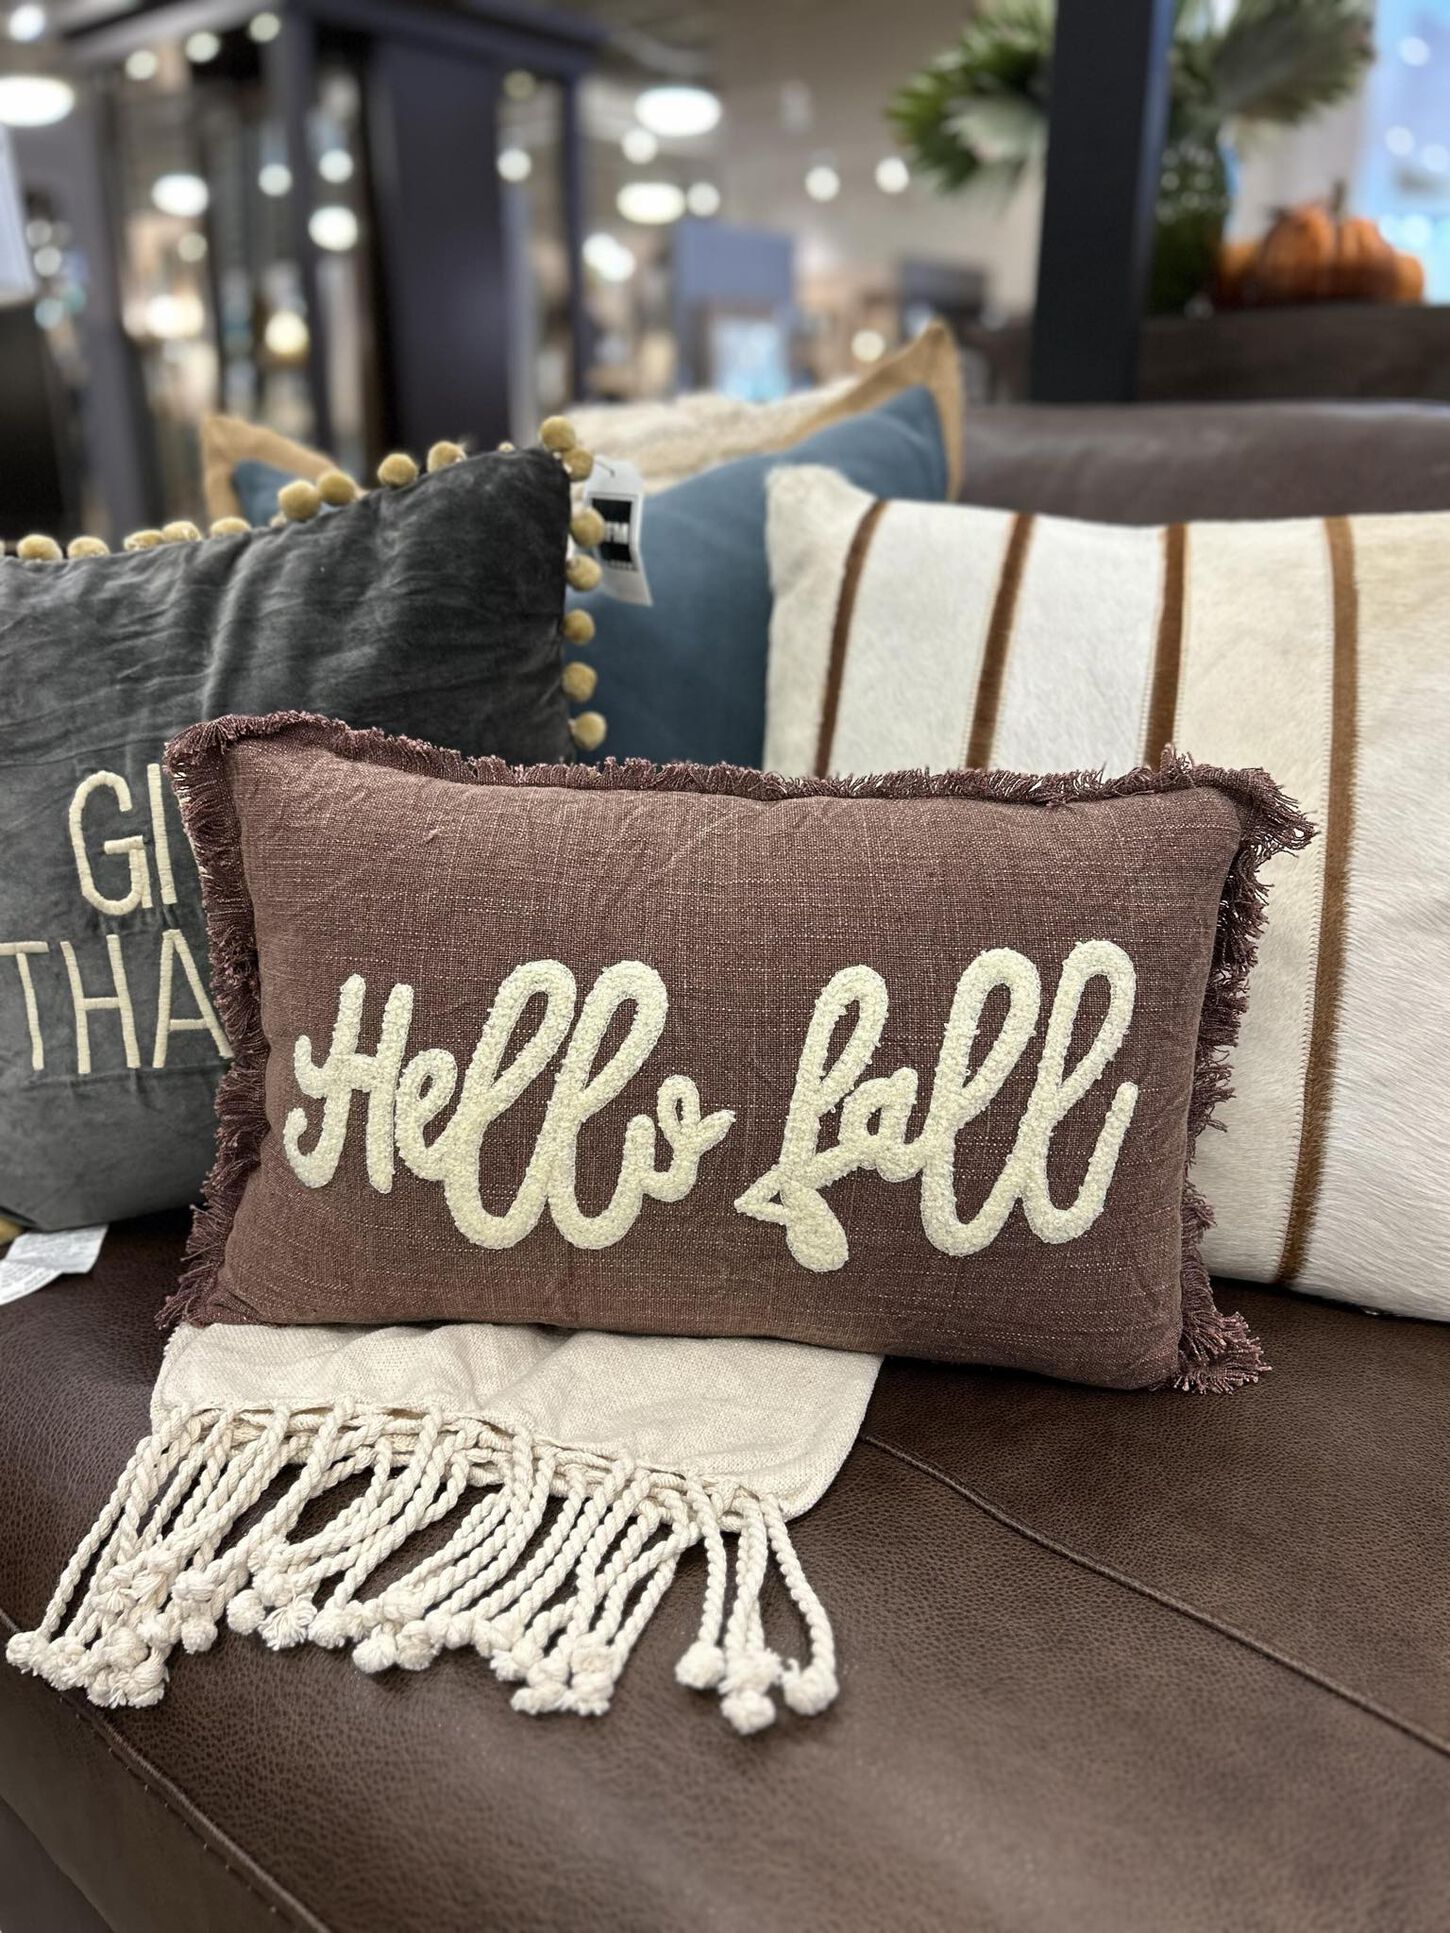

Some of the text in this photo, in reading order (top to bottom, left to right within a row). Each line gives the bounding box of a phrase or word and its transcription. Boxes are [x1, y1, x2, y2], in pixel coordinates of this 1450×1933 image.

[69, 763, 178, 916] GI
[0, 929, 234, 1074] THA
[284, 940, 1139, 1272] Hello fall
